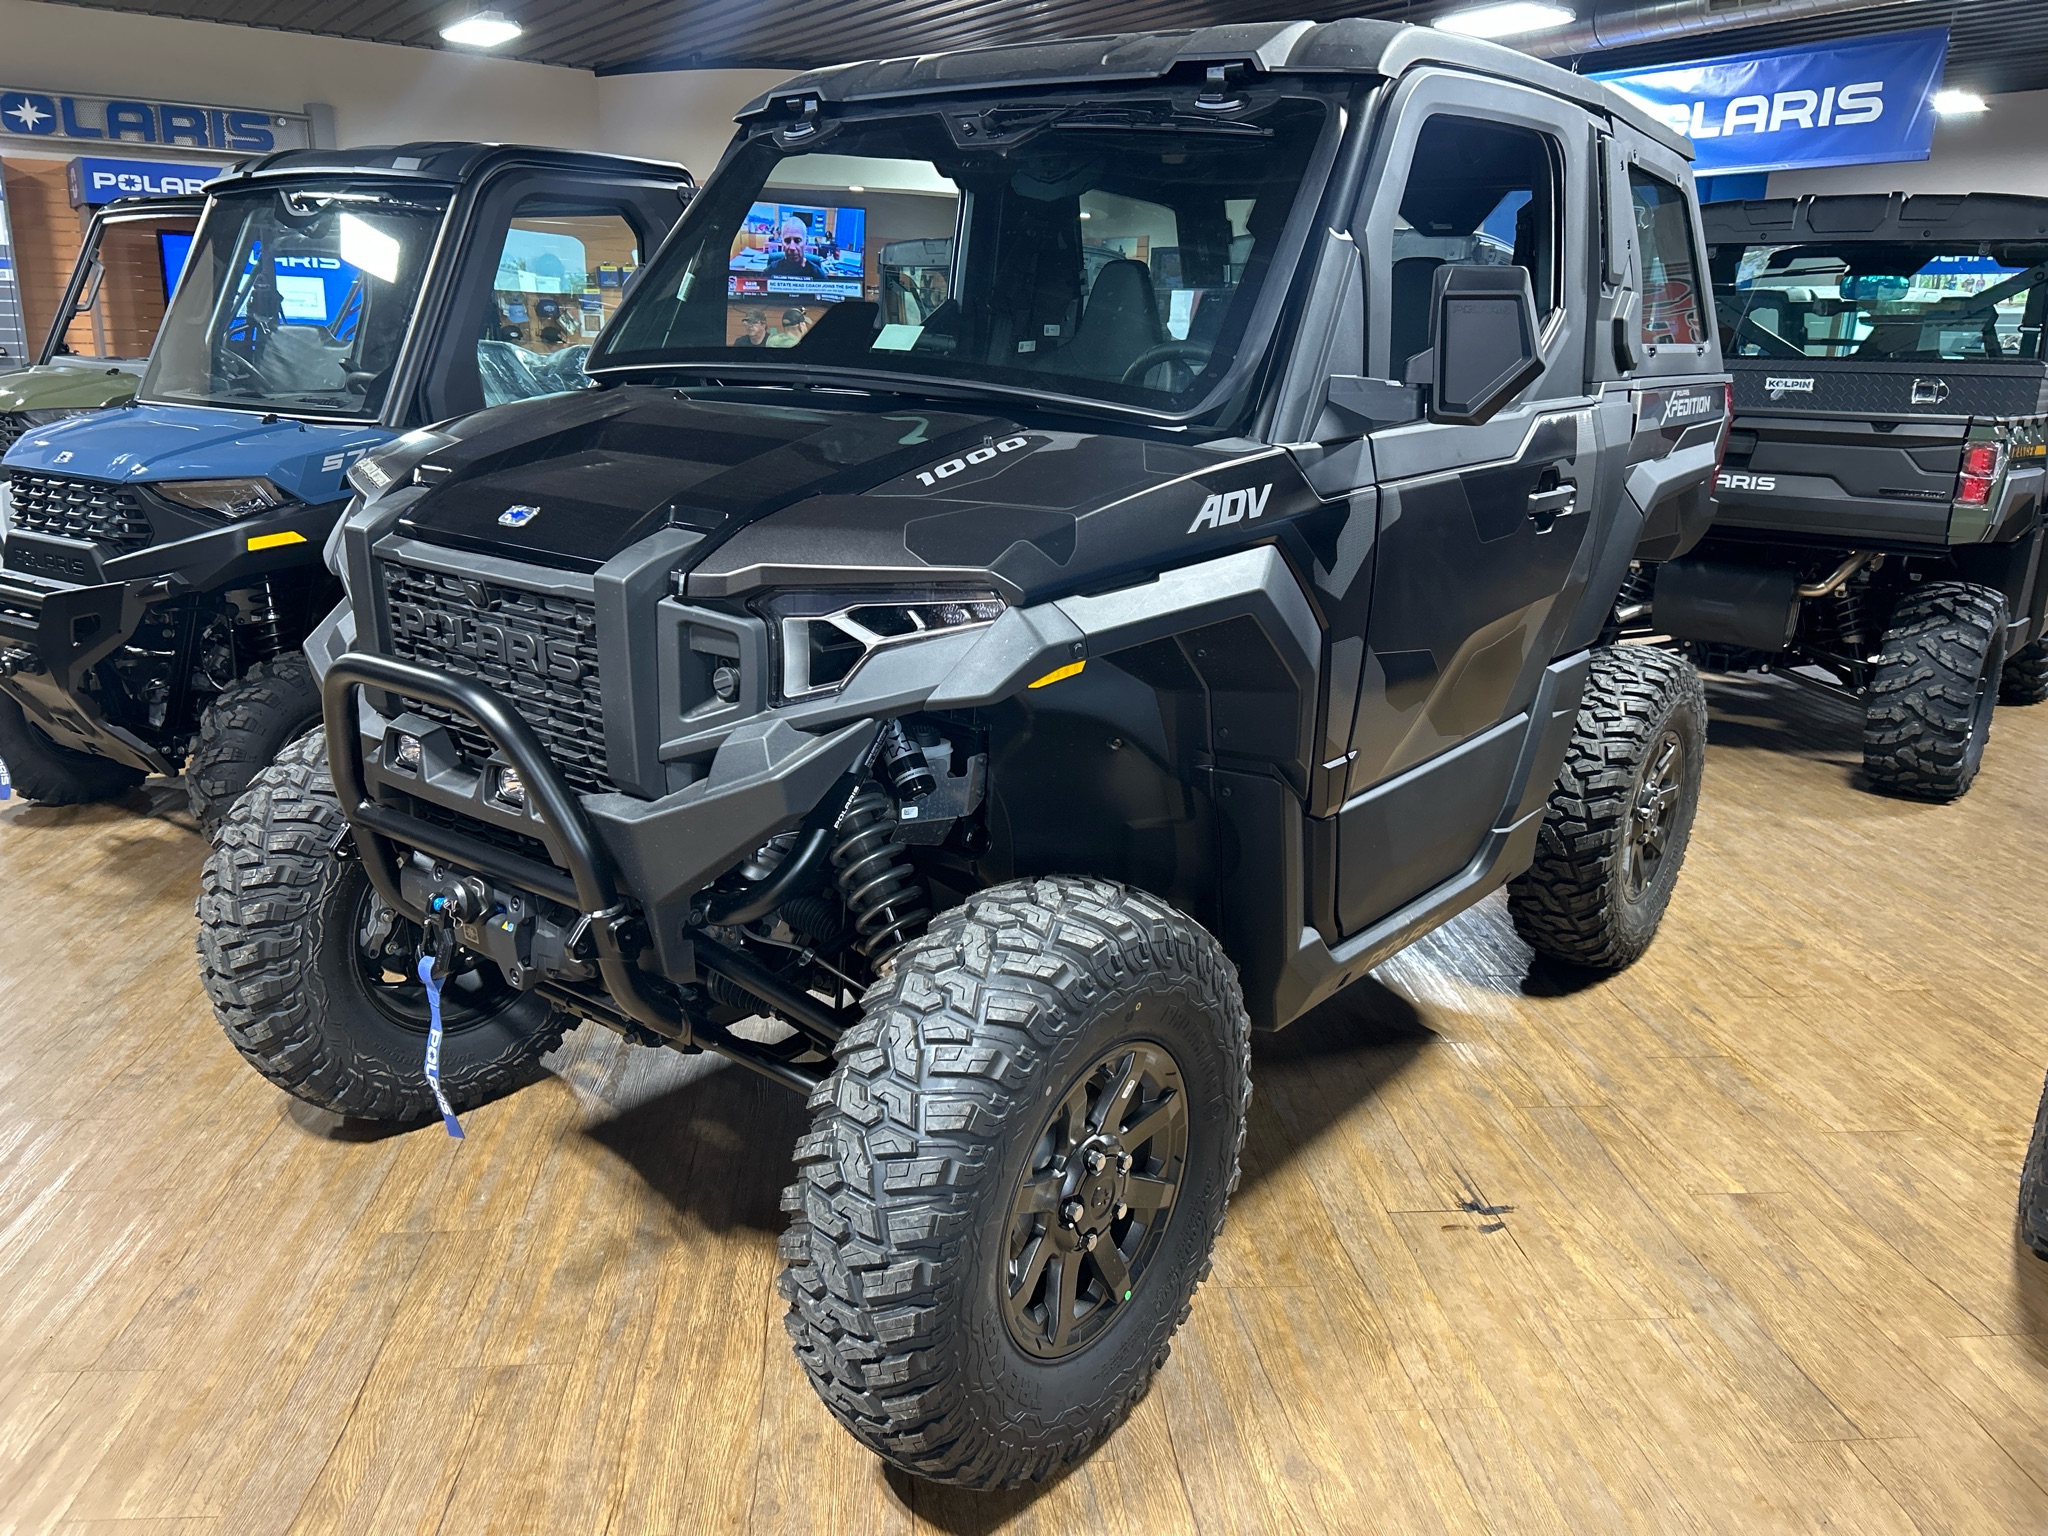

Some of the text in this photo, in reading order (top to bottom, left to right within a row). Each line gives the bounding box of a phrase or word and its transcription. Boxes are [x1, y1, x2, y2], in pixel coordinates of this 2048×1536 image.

[1768, 379, 1811, 389] KOLPIN
[1660, 390, 1711, 426] XPEDITION
[321, 446, 378, 473] 57
[916, 437, 1028, 487] 1000
[1186, 483, 1273, 534] ADV
[15, 549, 84, 576] POLARIS
[400, 602, 582, 682] POLARIS
[833, 785, 860, 830] POLARIS
